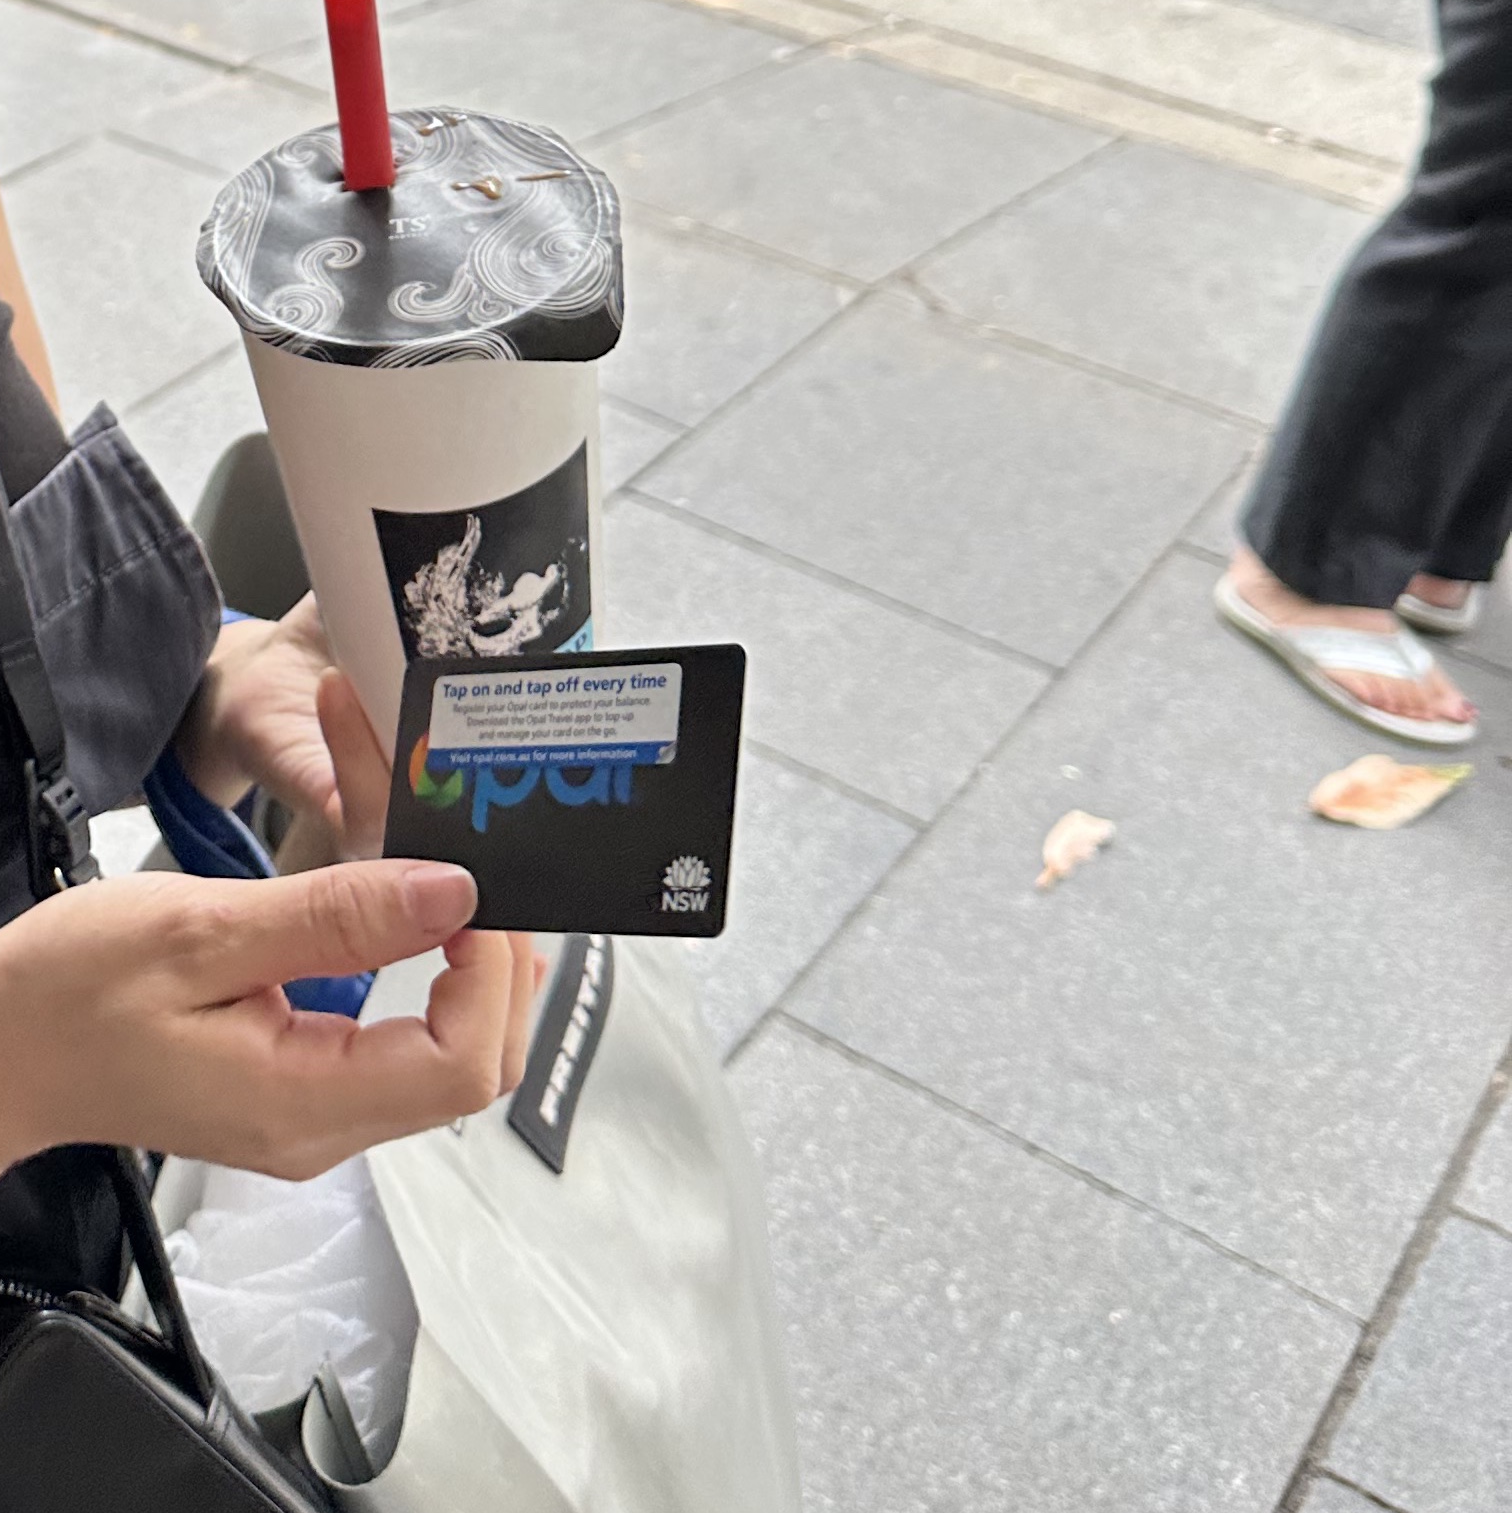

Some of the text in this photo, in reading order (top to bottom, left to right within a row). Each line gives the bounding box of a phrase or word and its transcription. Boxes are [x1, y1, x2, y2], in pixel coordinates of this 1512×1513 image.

[443, 672, 667, 700] Tap on and tap off every time
[453, 703, 485, 715] Register
[486, 704, 506, 716] your
[507, 700, 528, 714] Opal
[528, 700, 548, 710] card
[549, 700, 559, 709] to
[560, 698, 593, 711] protect
[593, 698, 614, 710] your
[466, 715, 509, 727] Download
[510, 714, 526, 725] the
[526, 713, 547, 726] Opal
[548, 712, 573, 724] Travel
[574, 713, 593, 725] app
[593, 712, 603, 722] to
[478, 728, 495, 740] and
[496, 730, 530, 742] manage
[531, 729, 551, 741] your
[552, 727, 572, 738] card
[573, 727, 586, 737] on
[587, 726, 602, 737] the
[450, 752, 471, 764] Visit
[532, 749, 548, 762] for
[549, 750, 575, 762] more
[576, 747, 637, 761] information
[661, 891, 711, 913] NSW
